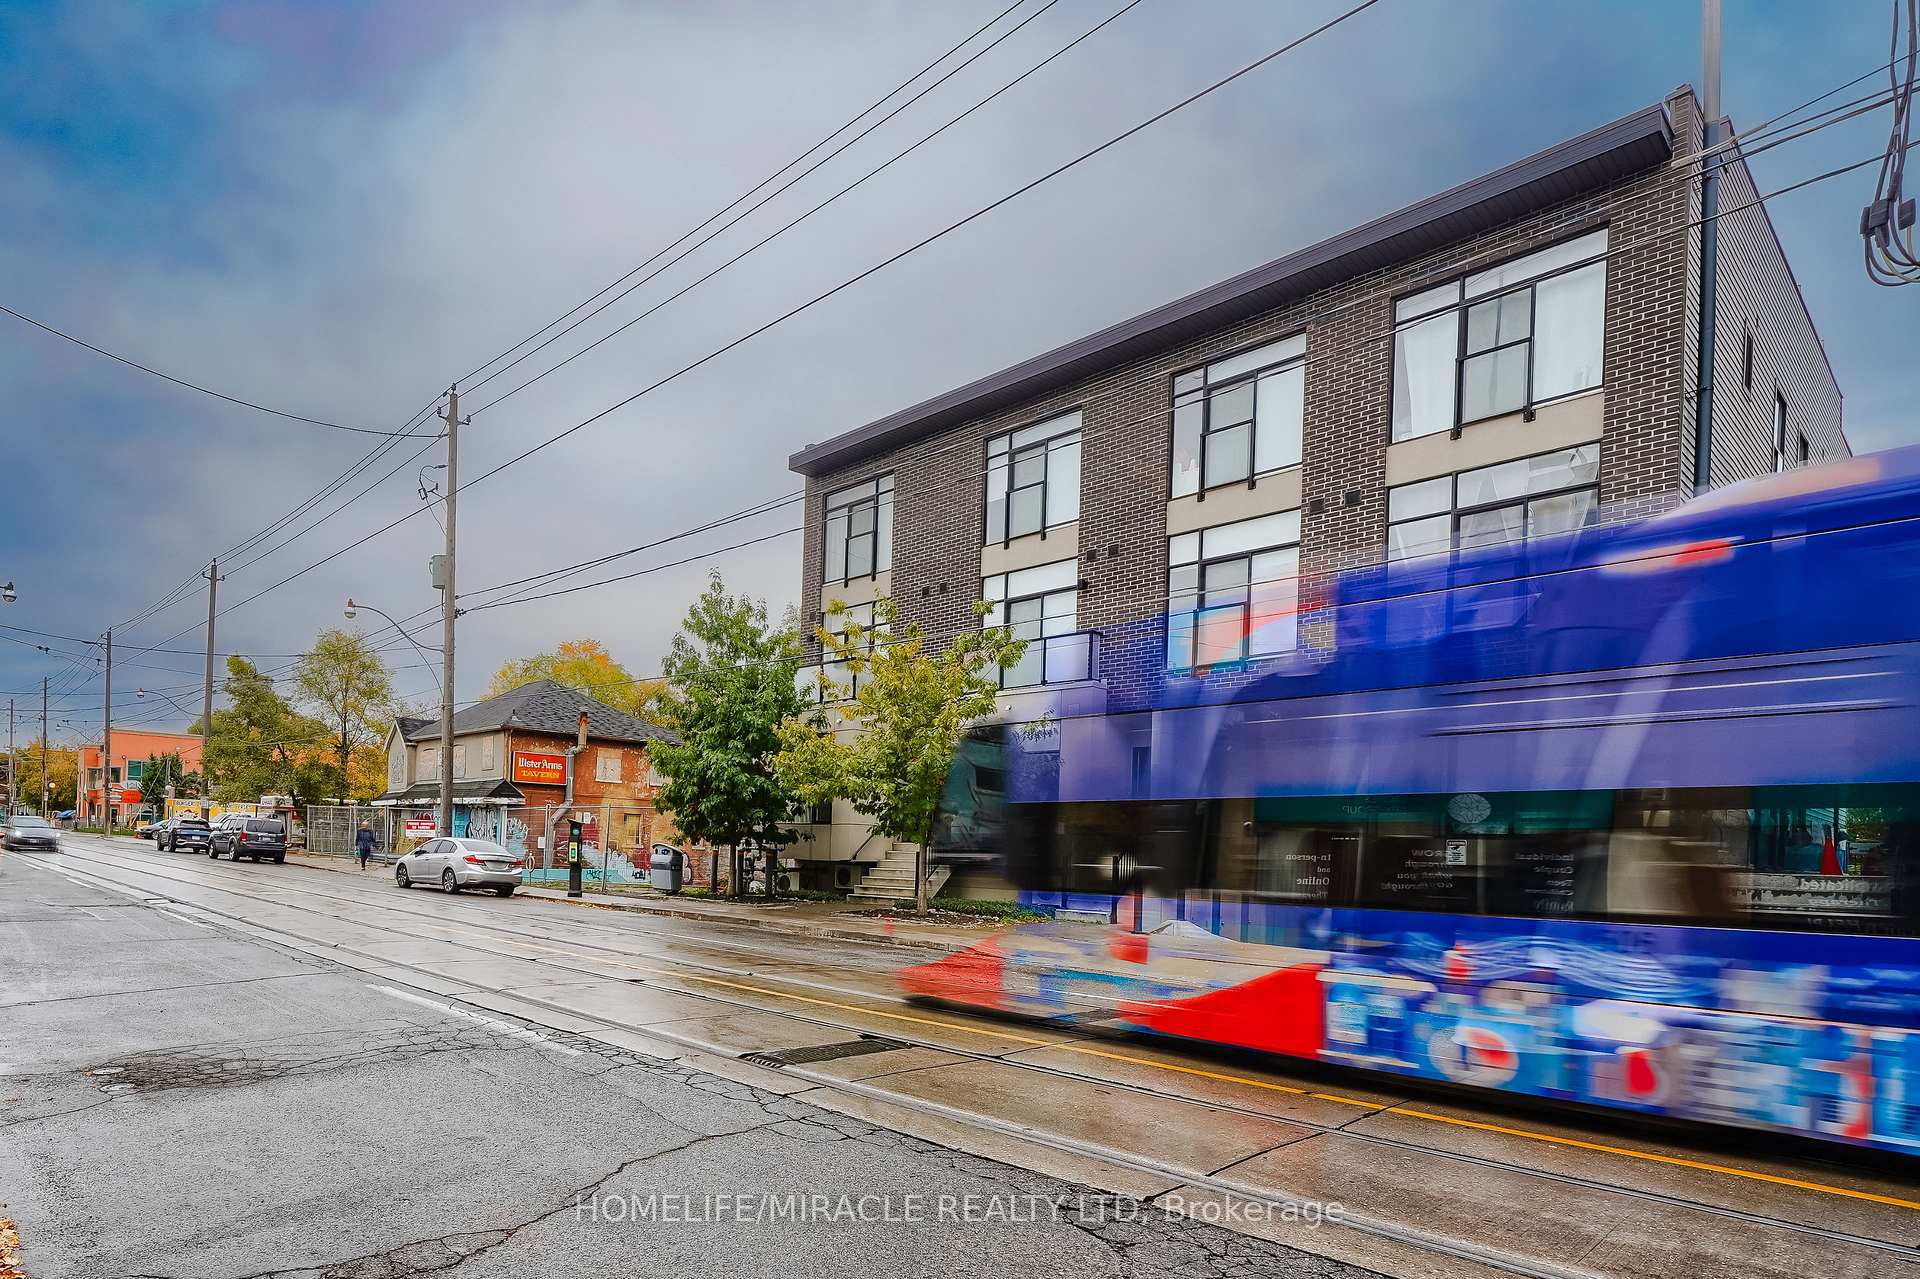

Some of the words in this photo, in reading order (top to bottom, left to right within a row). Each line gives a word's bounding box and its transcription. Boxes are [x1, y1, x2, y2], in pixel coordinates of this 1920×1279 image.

[518, 757, 541, 768] Ulster
[541, 759, 563, 770] Arms
[520, 770, 560, 779] TAVERN
